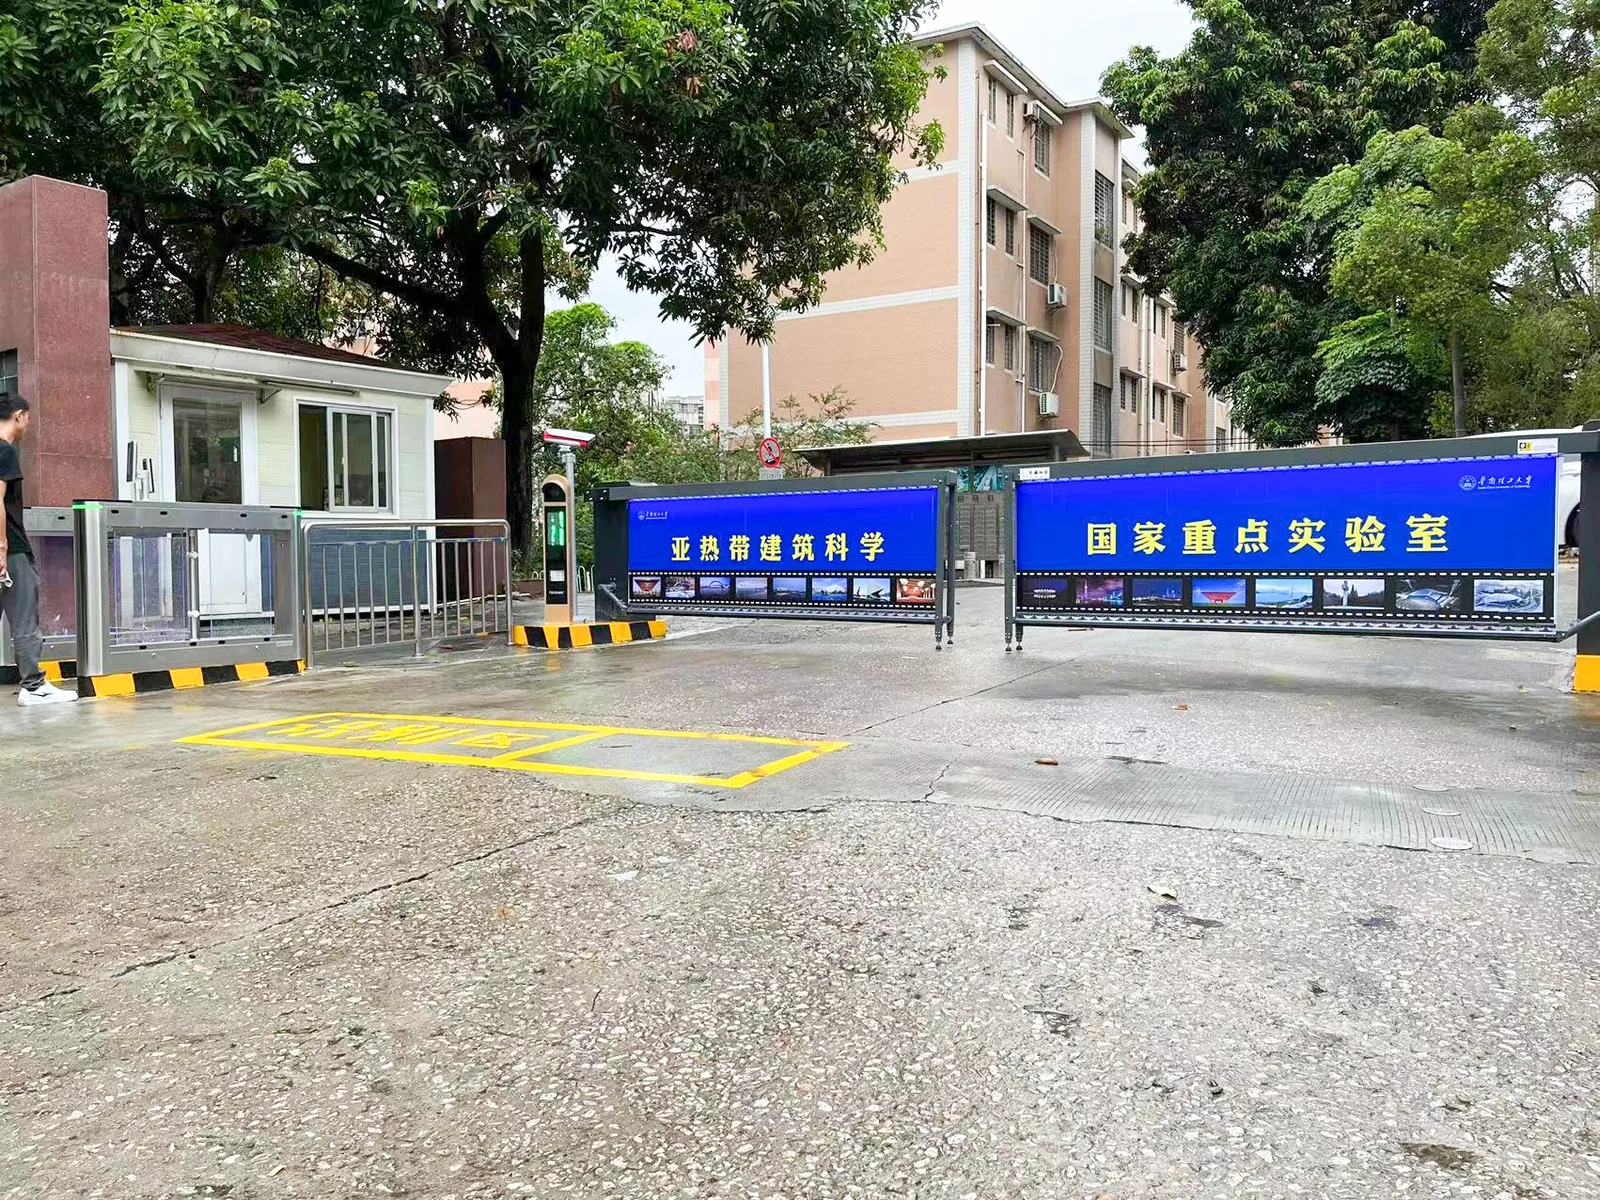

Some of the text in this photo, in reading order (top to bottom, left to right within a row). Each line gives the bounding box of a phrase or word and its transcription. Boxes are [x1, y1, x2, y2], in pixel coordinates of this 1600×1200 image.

[672, 532, 884, 561] 亚热带建筑科学
[1088, 514, 1448, 555] 国家重点实验室
